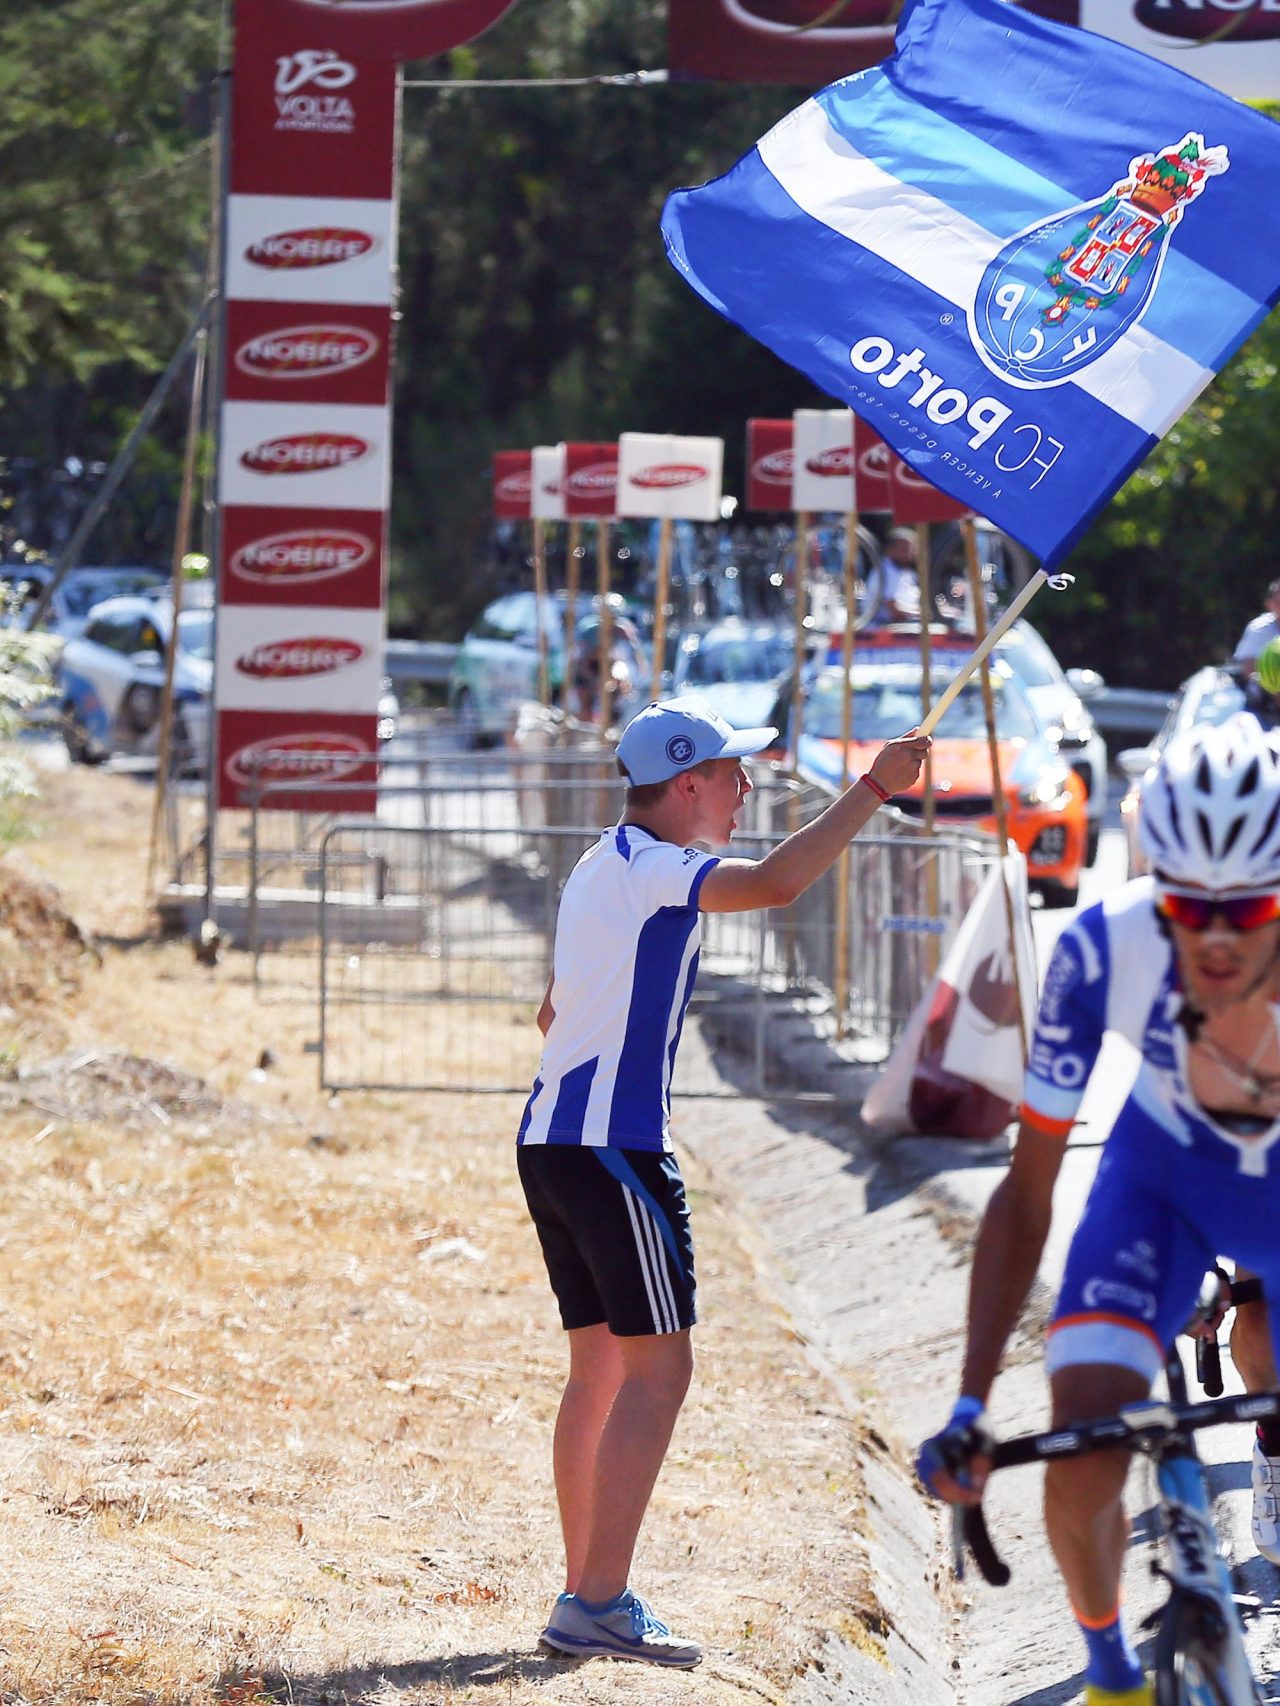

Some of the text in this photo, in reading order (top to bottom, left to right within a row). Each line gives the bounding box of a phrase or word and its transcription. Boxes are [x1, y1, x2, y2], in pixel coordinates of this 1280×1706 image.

[274, 95, 354, 118] VOLTA
[250, 235, 364, 261] NOBRE
[249, 338, 362, 363] NOBRE
[248, 440, 360, 467] NOBRE
[246, 542, 358, 568] NOBRE
[244, 644, 354, 670] NOBRE
